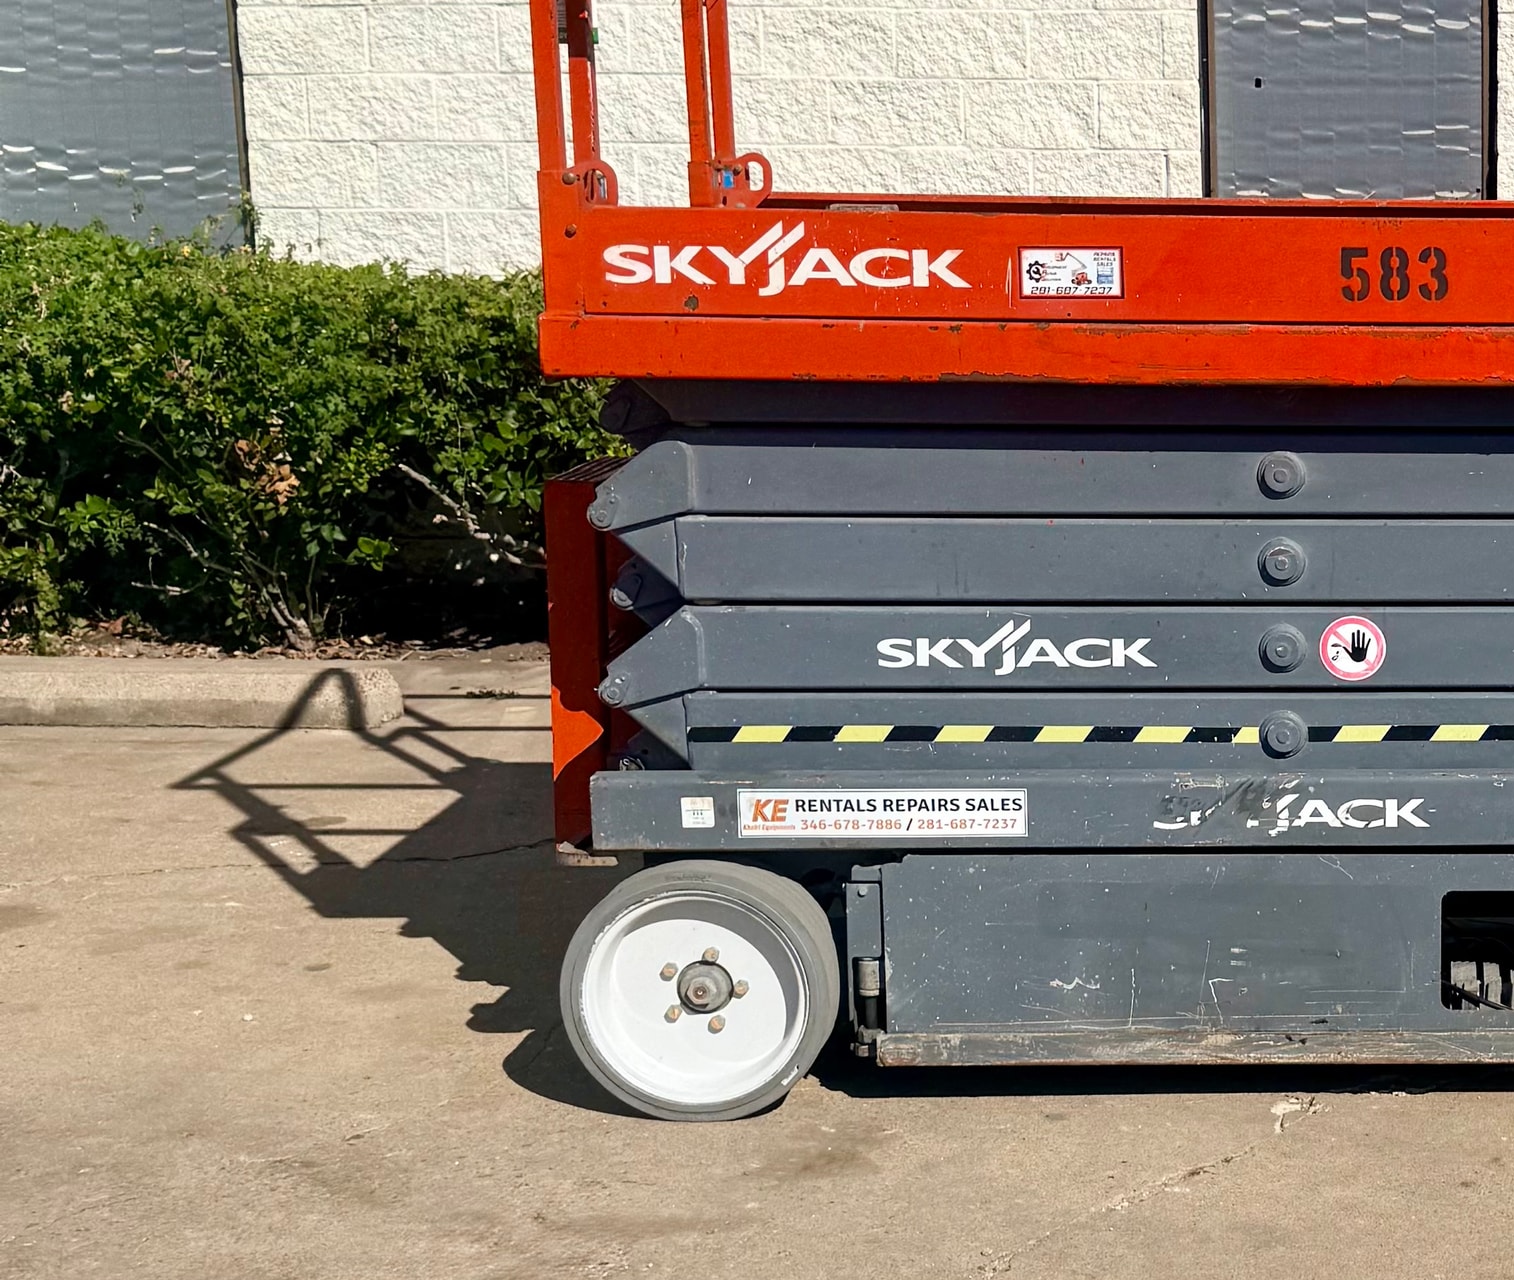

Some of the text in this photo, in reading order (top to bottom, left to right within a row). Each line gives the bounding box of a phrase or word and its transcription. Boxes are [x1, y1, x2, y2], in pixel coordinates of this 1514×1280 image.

[602, 219, 974, 297] SKYJACK
[1340, 246, 1449, 302] 583
[876, 619, 1159, 676] SKYJACK
[751, 798, 790, 822] KE
[795, 798, 1023, 812] RENTALS REPAIRS SALES
[800, 817, 1017, 831] 346-678-7886 / 281-687-7237
